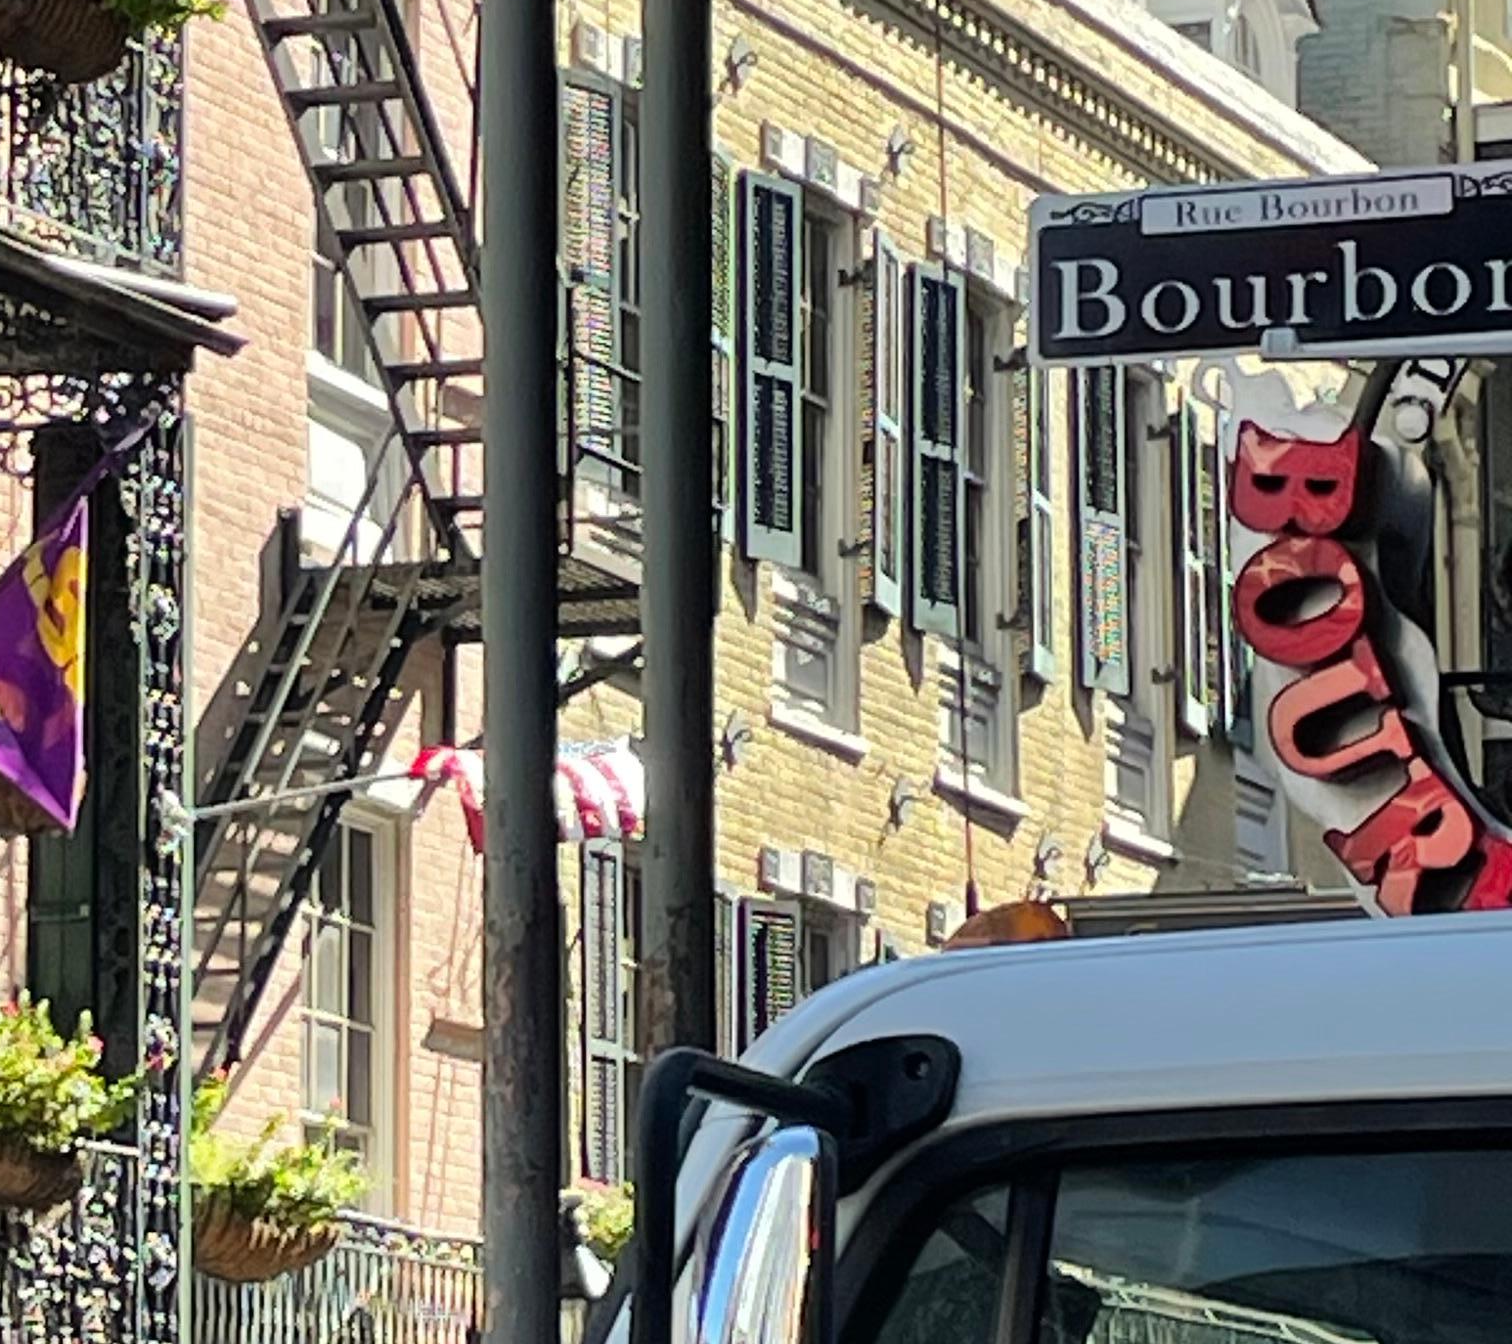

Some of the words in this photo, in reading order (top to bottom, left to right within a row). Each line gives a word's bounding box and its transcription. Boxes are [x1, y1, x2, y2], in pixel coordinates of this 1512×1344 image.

[1175, 200, 1242, 228] Rue
[1259, 188, 1420, 226] Bourbon
[1228, 418, 1512, 920] BOUR
